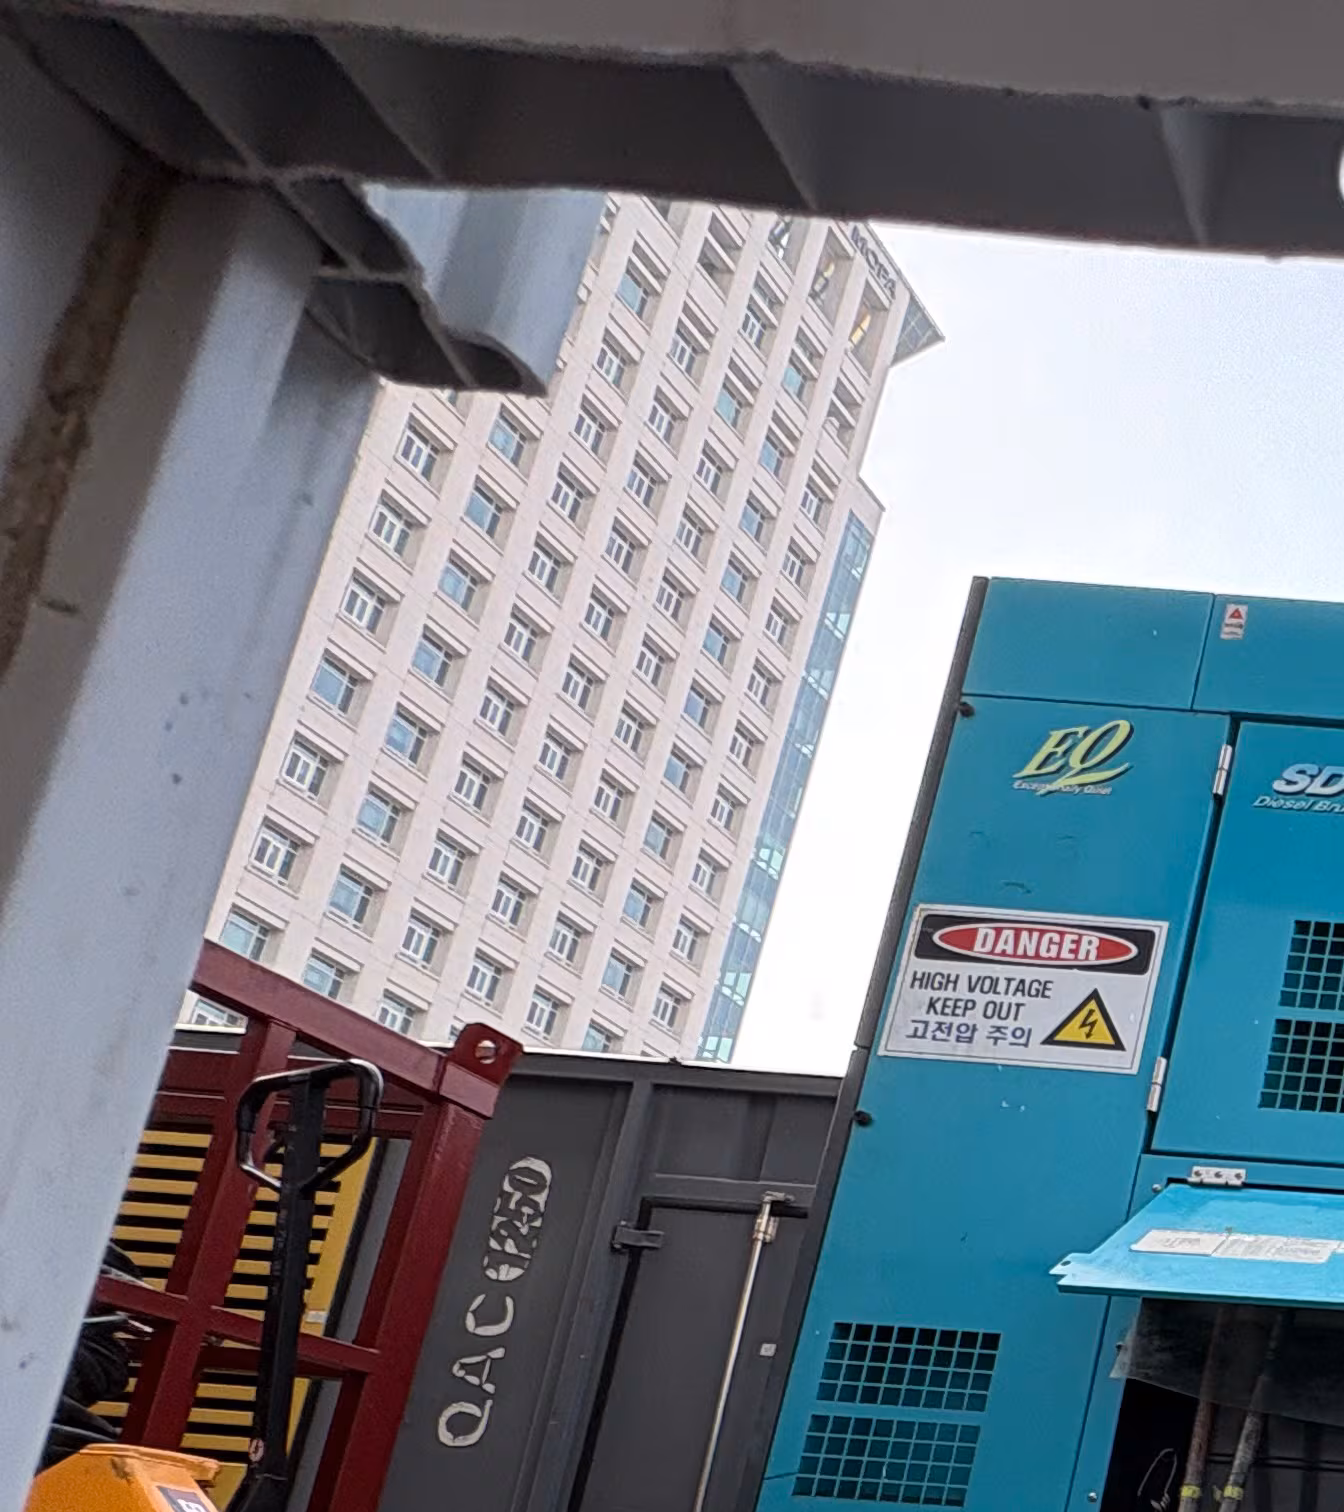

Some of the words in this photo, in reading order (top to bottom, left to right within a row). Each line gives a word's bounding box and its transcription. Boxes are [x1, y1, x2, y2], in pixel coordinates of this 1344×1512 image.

[1012, 719, 1135, 796] EQ
[1252, 795, 1312, 811] Diesel
[973, 927, 1100, 961] DANGER
[909, 970, 959, 993] HIGH
[967, 974, 1054, 999] VOLTAGE
[925, 996, 977, 1018] KEEP
[983, 1000, 1025, 1022] OUT
[905, 1018, 978, 1045] 고전압
[985, 1025, 1033, 1049] 주의
[438, 1293, 514, 1447] QAC
